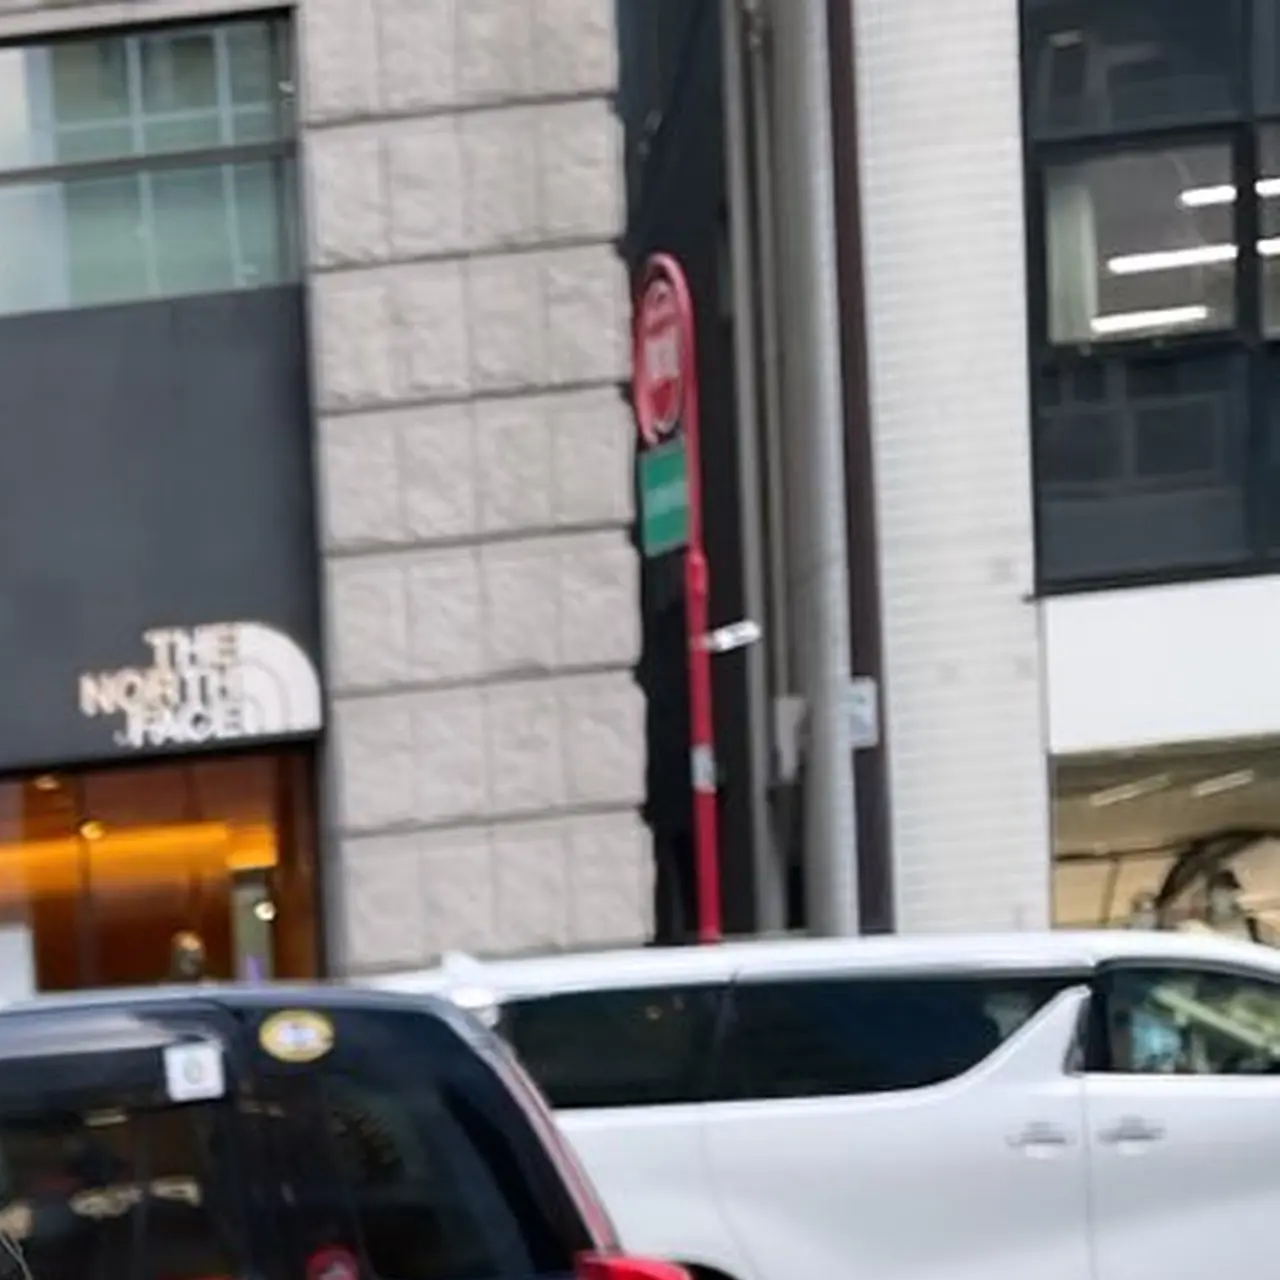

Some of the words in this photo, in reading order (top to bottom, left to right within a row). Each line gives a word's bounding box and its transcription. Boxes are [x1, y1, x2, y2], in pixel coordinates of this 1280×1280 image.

[143, 622, 239, 671] THE
[78, 664, 241, 717] NORTH
[114, 699, 243, 747] FACE
